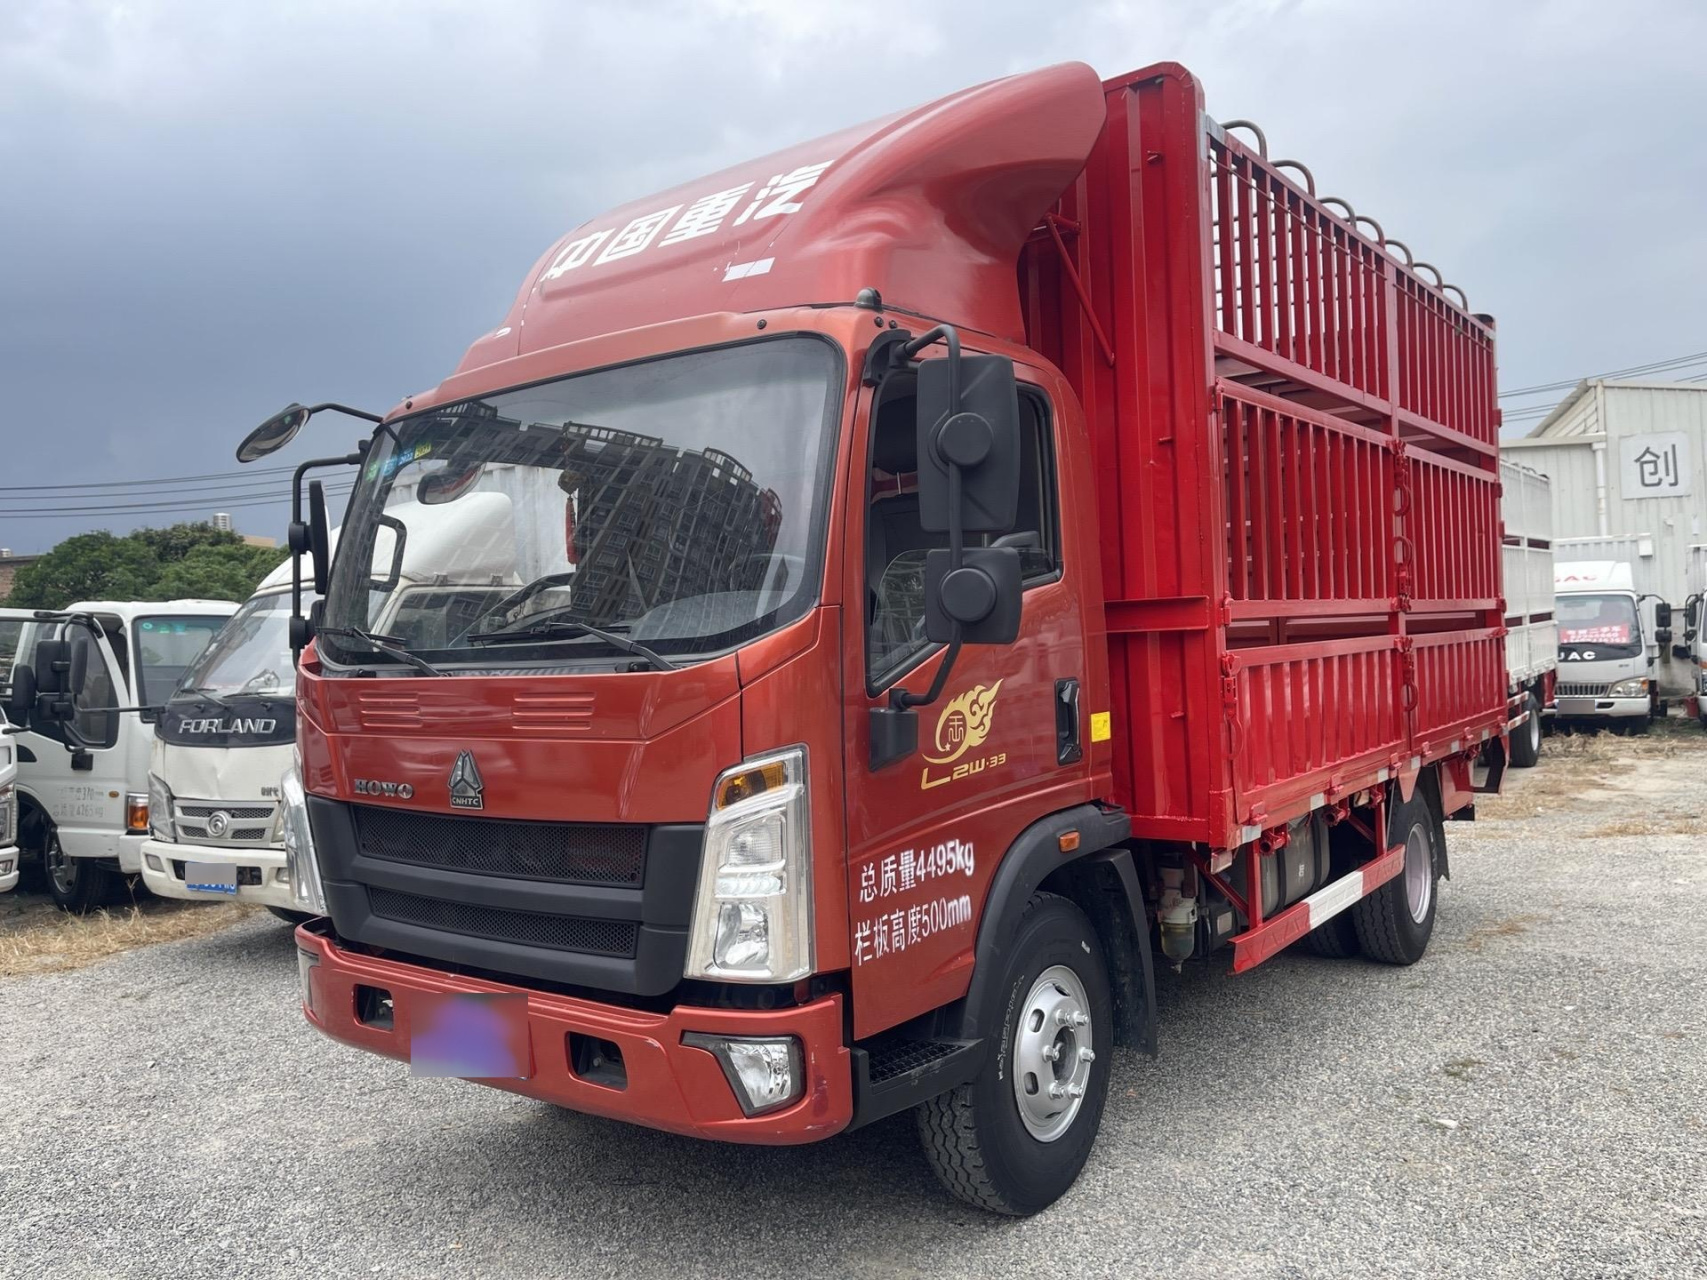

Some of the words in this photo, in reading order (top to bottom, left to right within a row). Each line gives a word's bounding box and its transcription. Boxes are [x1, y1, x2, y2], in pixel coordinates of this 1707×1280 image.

[540, 160, 835, 281] 中国重汽
[1634, 444, 1678, 487] 创
[178, 718, 276, 734] FORLAND
[354, 779, 413, 799] HOWO
[451, 796, 479, 805] CNHTC
[860, 839, 975, 903] 总质量4495kg
[855, 894, 972, 966] 栏板高度500mm
